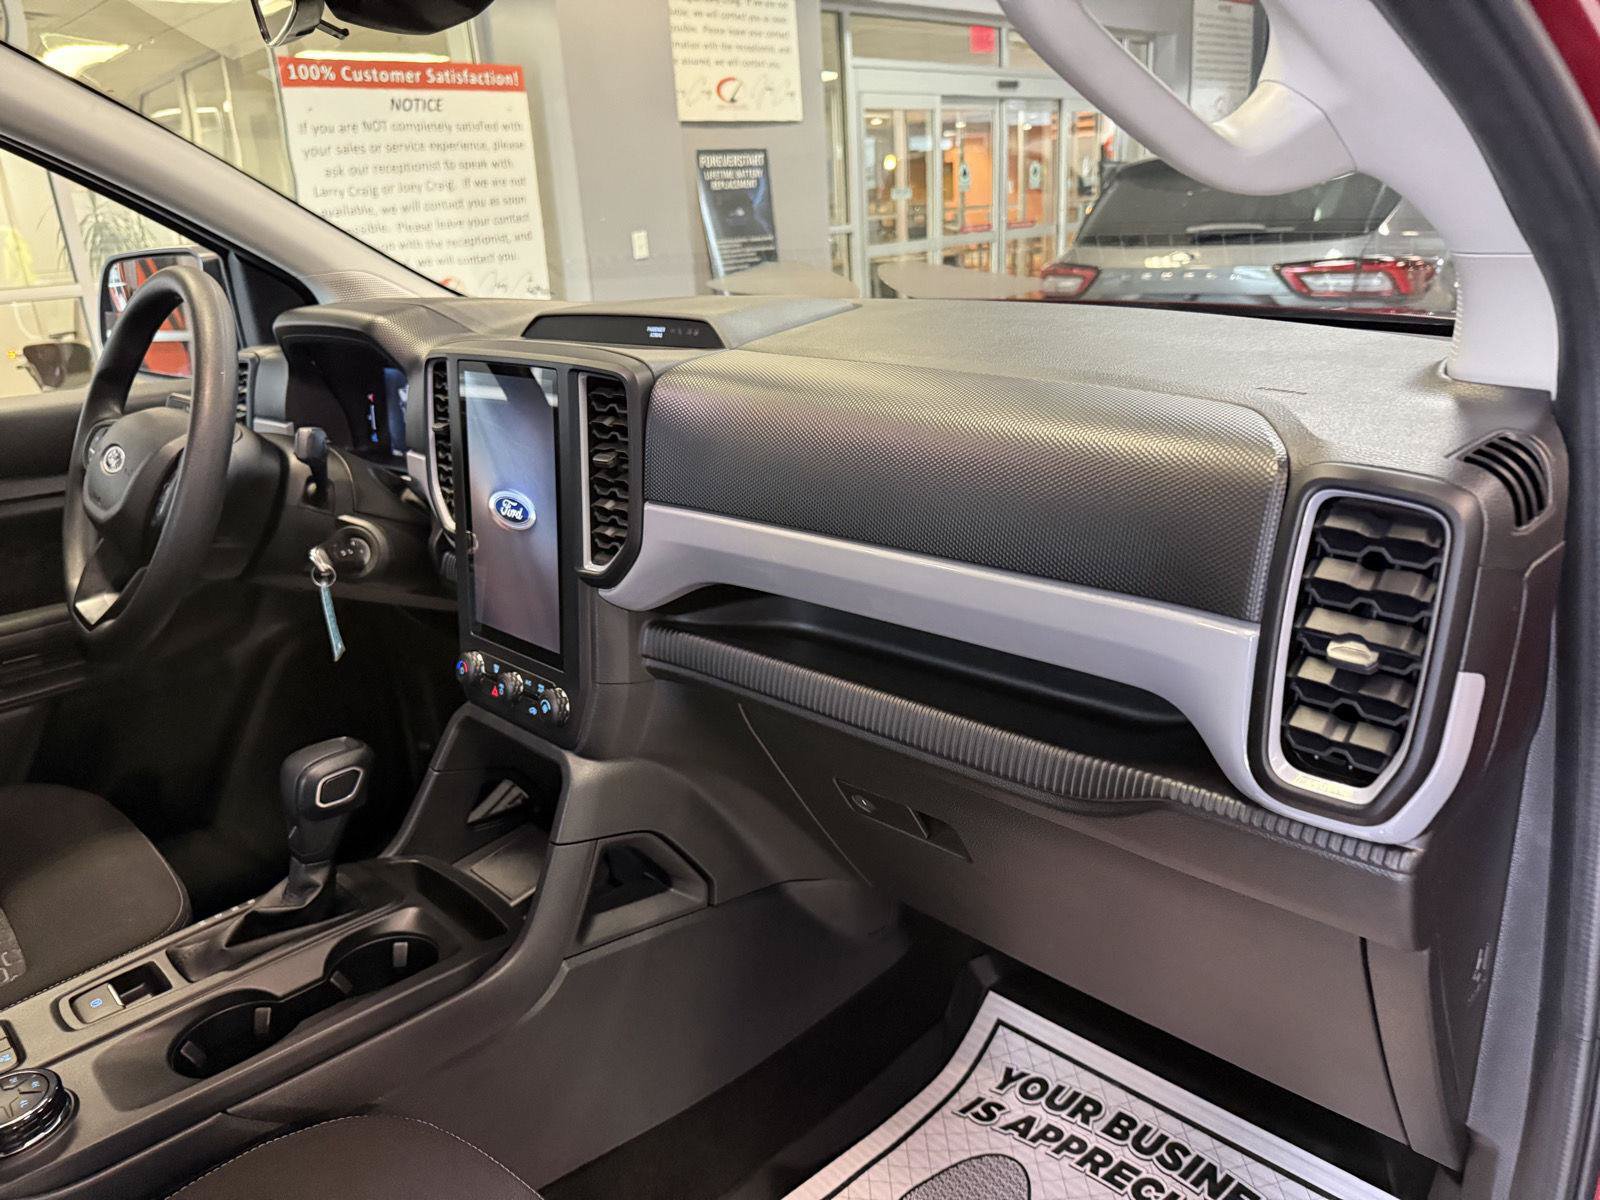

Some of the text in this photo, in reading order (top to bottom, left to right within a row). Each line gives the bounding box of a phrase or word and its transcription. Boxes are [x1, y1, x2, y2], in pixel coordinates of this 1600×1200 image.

[287, 63, 520, 87] 100% Customer Satisfaction!
[391, 98, 444, 113] NOTICE
[312, 124, 336, 137] you
[337, 122, 359, 134] are
[362, 119, 388, 133] NOT
[303, 144, 331, 159] your
[336, 142, 367, 155] sales
[385, 141, 426, 154] service
[500, 498, 524, 521] Ford
[994, 1065, 1104, 1127] YOUR
[955, 1095, 1007, 1125] IS
